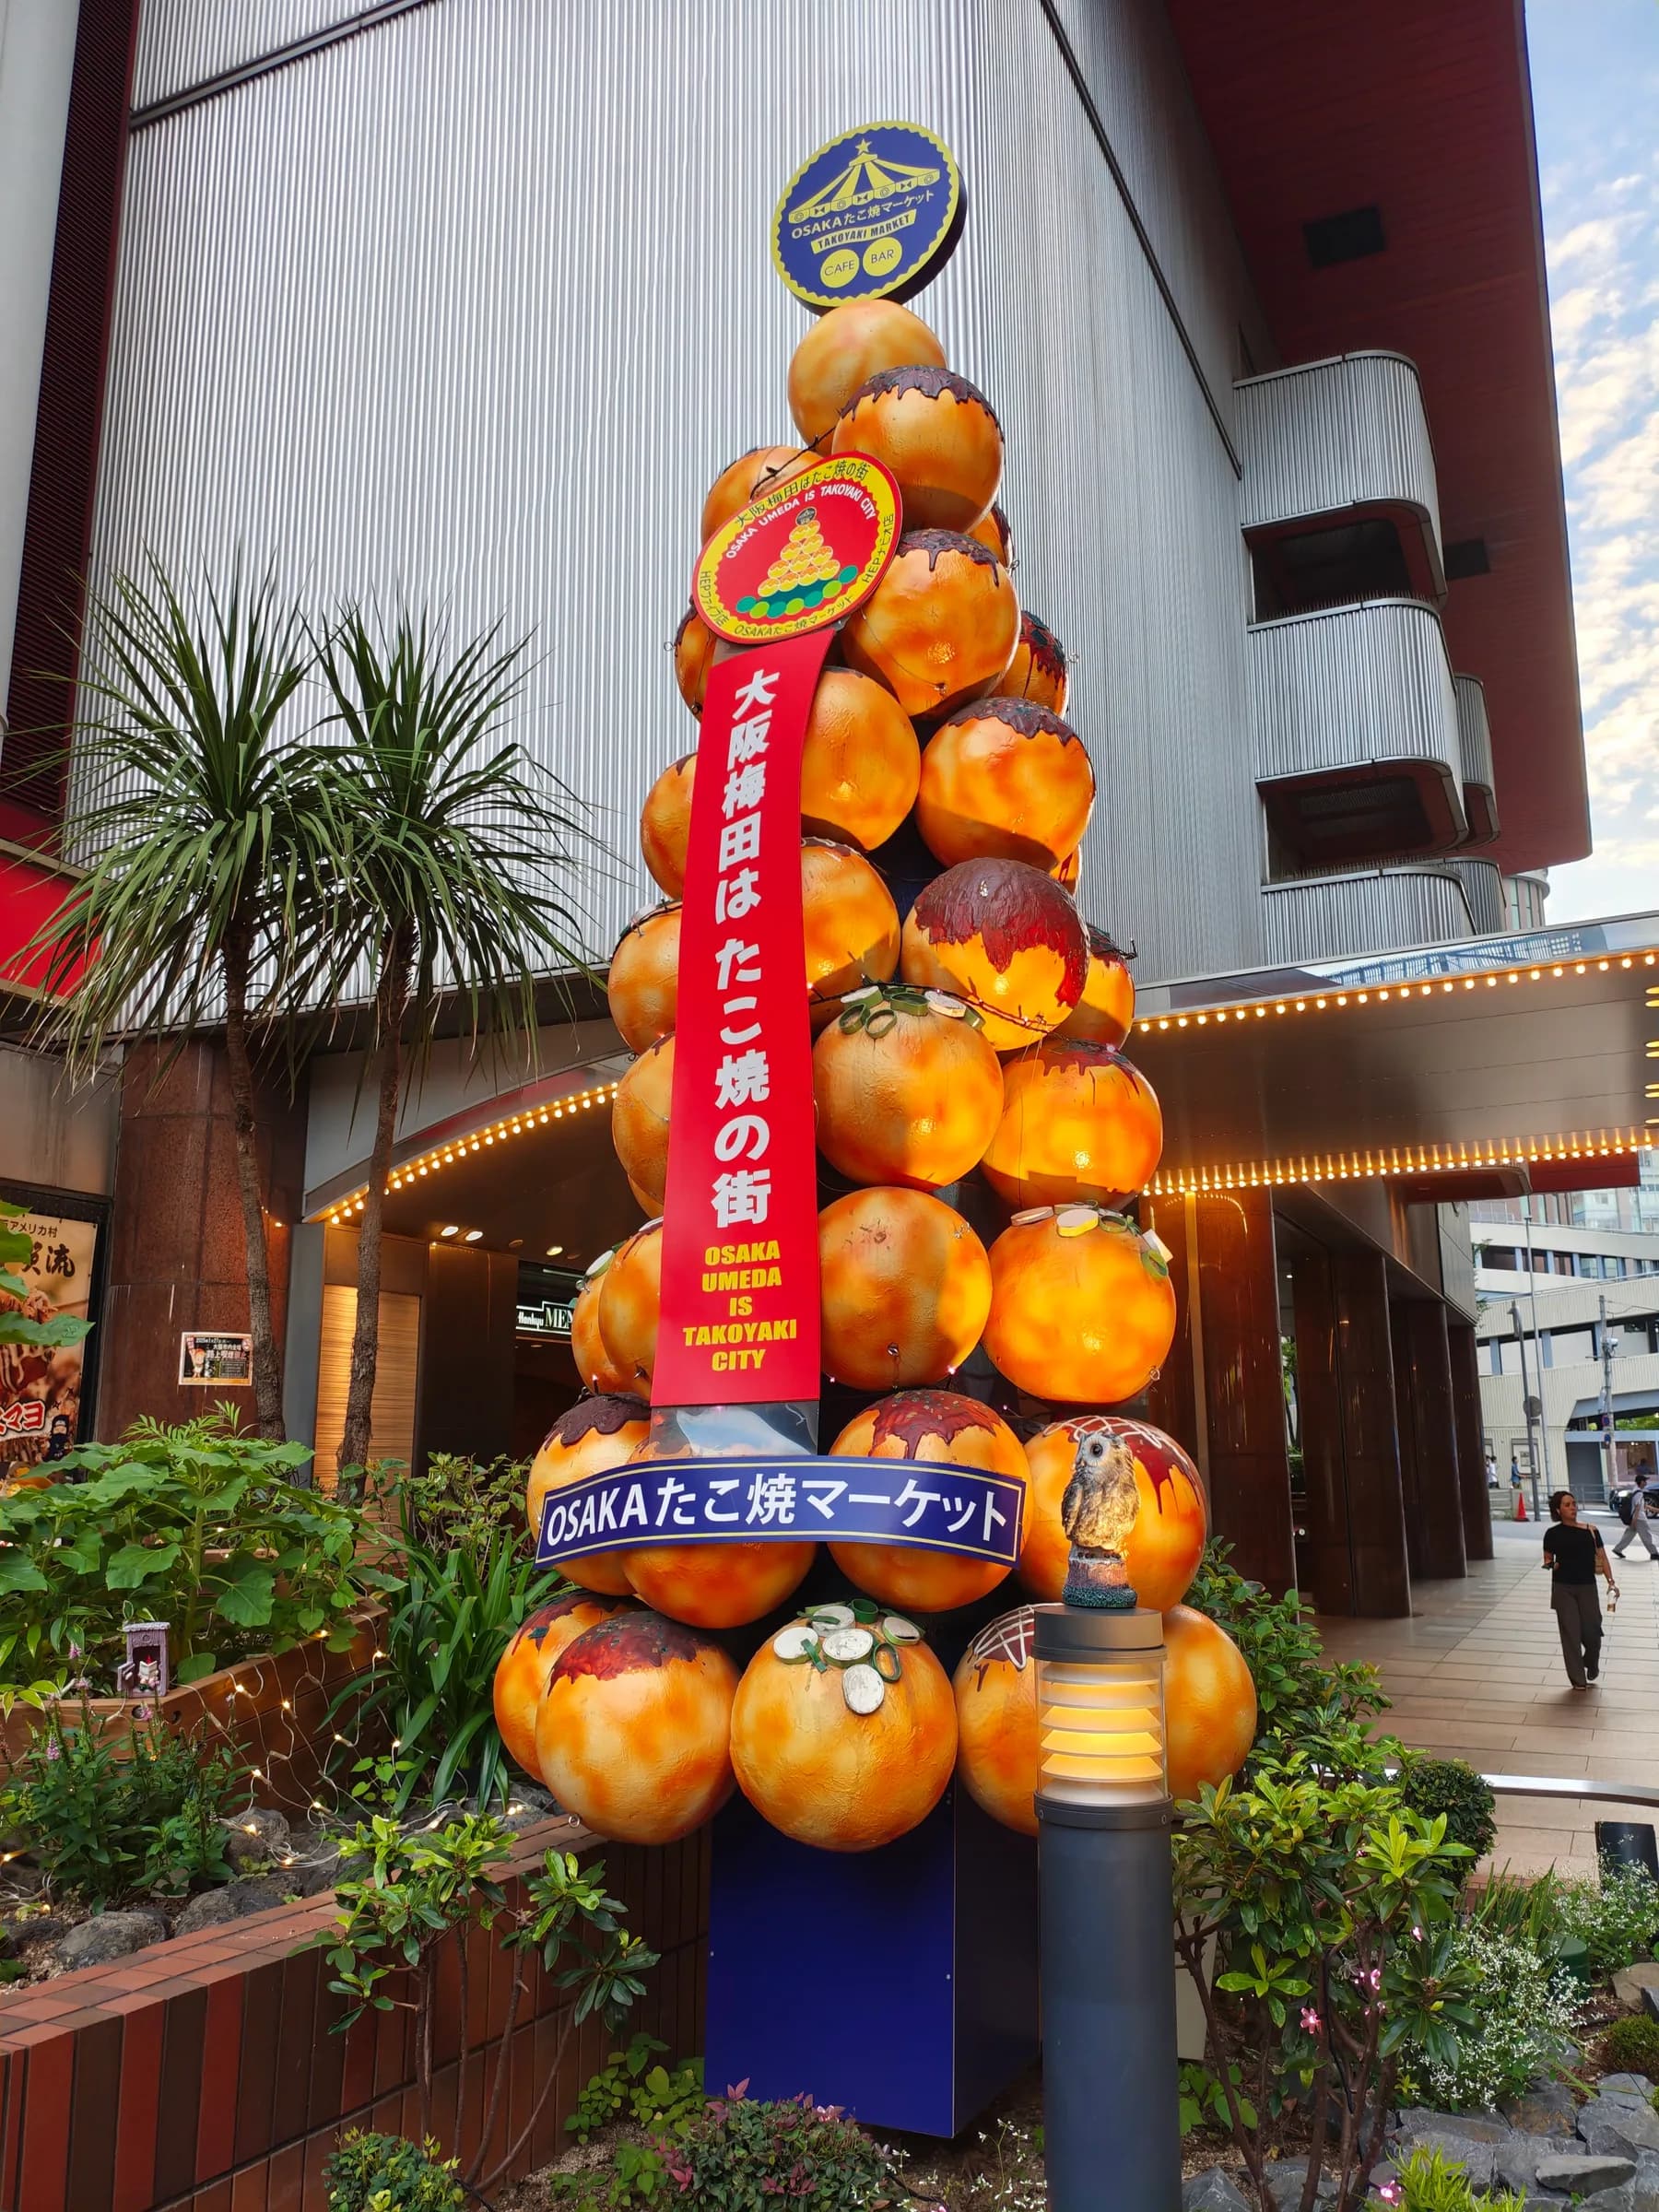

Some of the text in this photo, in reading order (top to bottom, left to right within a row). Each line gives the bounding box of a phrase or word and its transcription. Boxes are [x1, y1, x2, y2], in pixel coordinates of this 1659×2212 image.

[792, 190, 935, 240] OSAKAたこ焼マーケット
[818, 214, 911, 250] TAKOYAKI MARKET
[824, 259, 855, 276] CAFE
[870, 249, 894, 264] BAR
[735, 459, 871, 527] 大阪梅田はたこ焼の街
[725, 527, 758, 559] OSAKA
[758, 498, 800, 526] UMEDA
[805, 489, 816, 502] IS
[819, 483, 864, 502] TAKOYAKI
[860, 498, 877, 520] CITY
[735, 595, 853, 636] OSAKAたこ焼マーケット
[704, 1240, 781, 1266] OSAKA
[701, 1266, 782, 1292] UMEDA
[729, 1296, 753, 1317] IS
[682, 1319, 797, 1347] TAKOYAKI
[712, 1349, 767, 1371] CITY
[0, 1400, 45, 1435] マヨ
[547, 1473, 1007, 1547] OSAKAたこ焼マーケット
